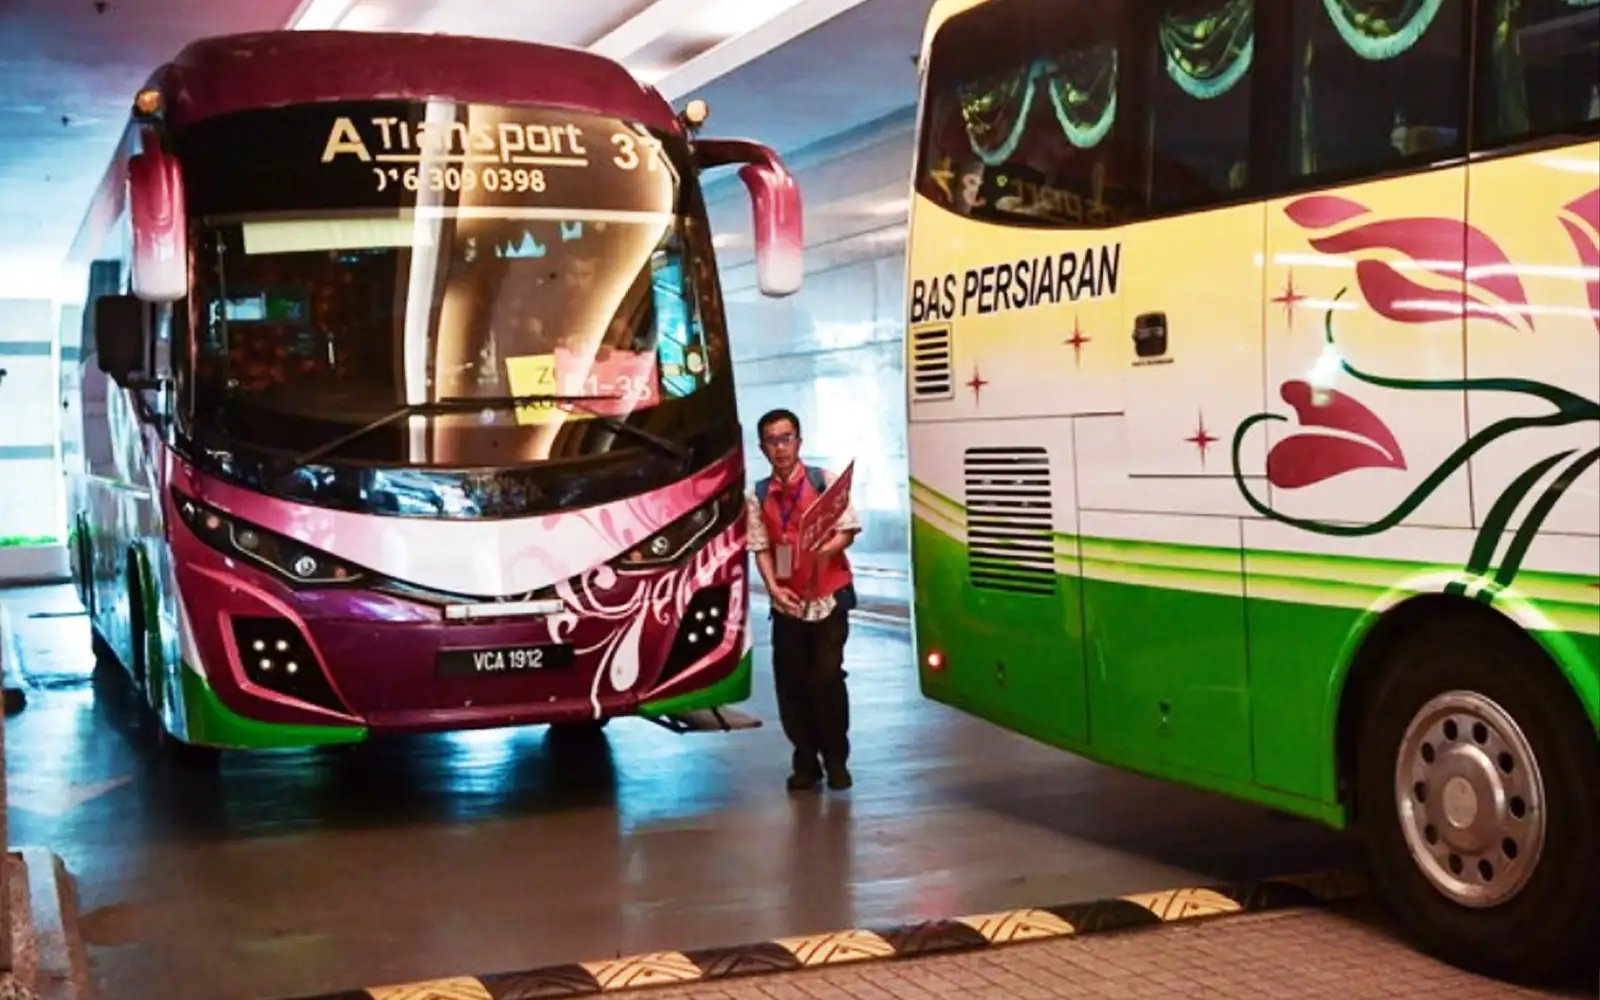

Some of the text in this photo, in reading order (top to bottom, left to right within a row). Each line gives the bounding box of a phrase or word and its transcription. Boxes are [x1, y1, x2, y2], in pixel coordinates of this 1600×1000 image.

[320, 117, 372, 163] A
[610, 132, 661, 171] 37
[482, 167, 547, 193] 0398
[910, 242, 1121, 323] BAS PERSIARAN
[472, 649, 544, 672] VCA 1912
